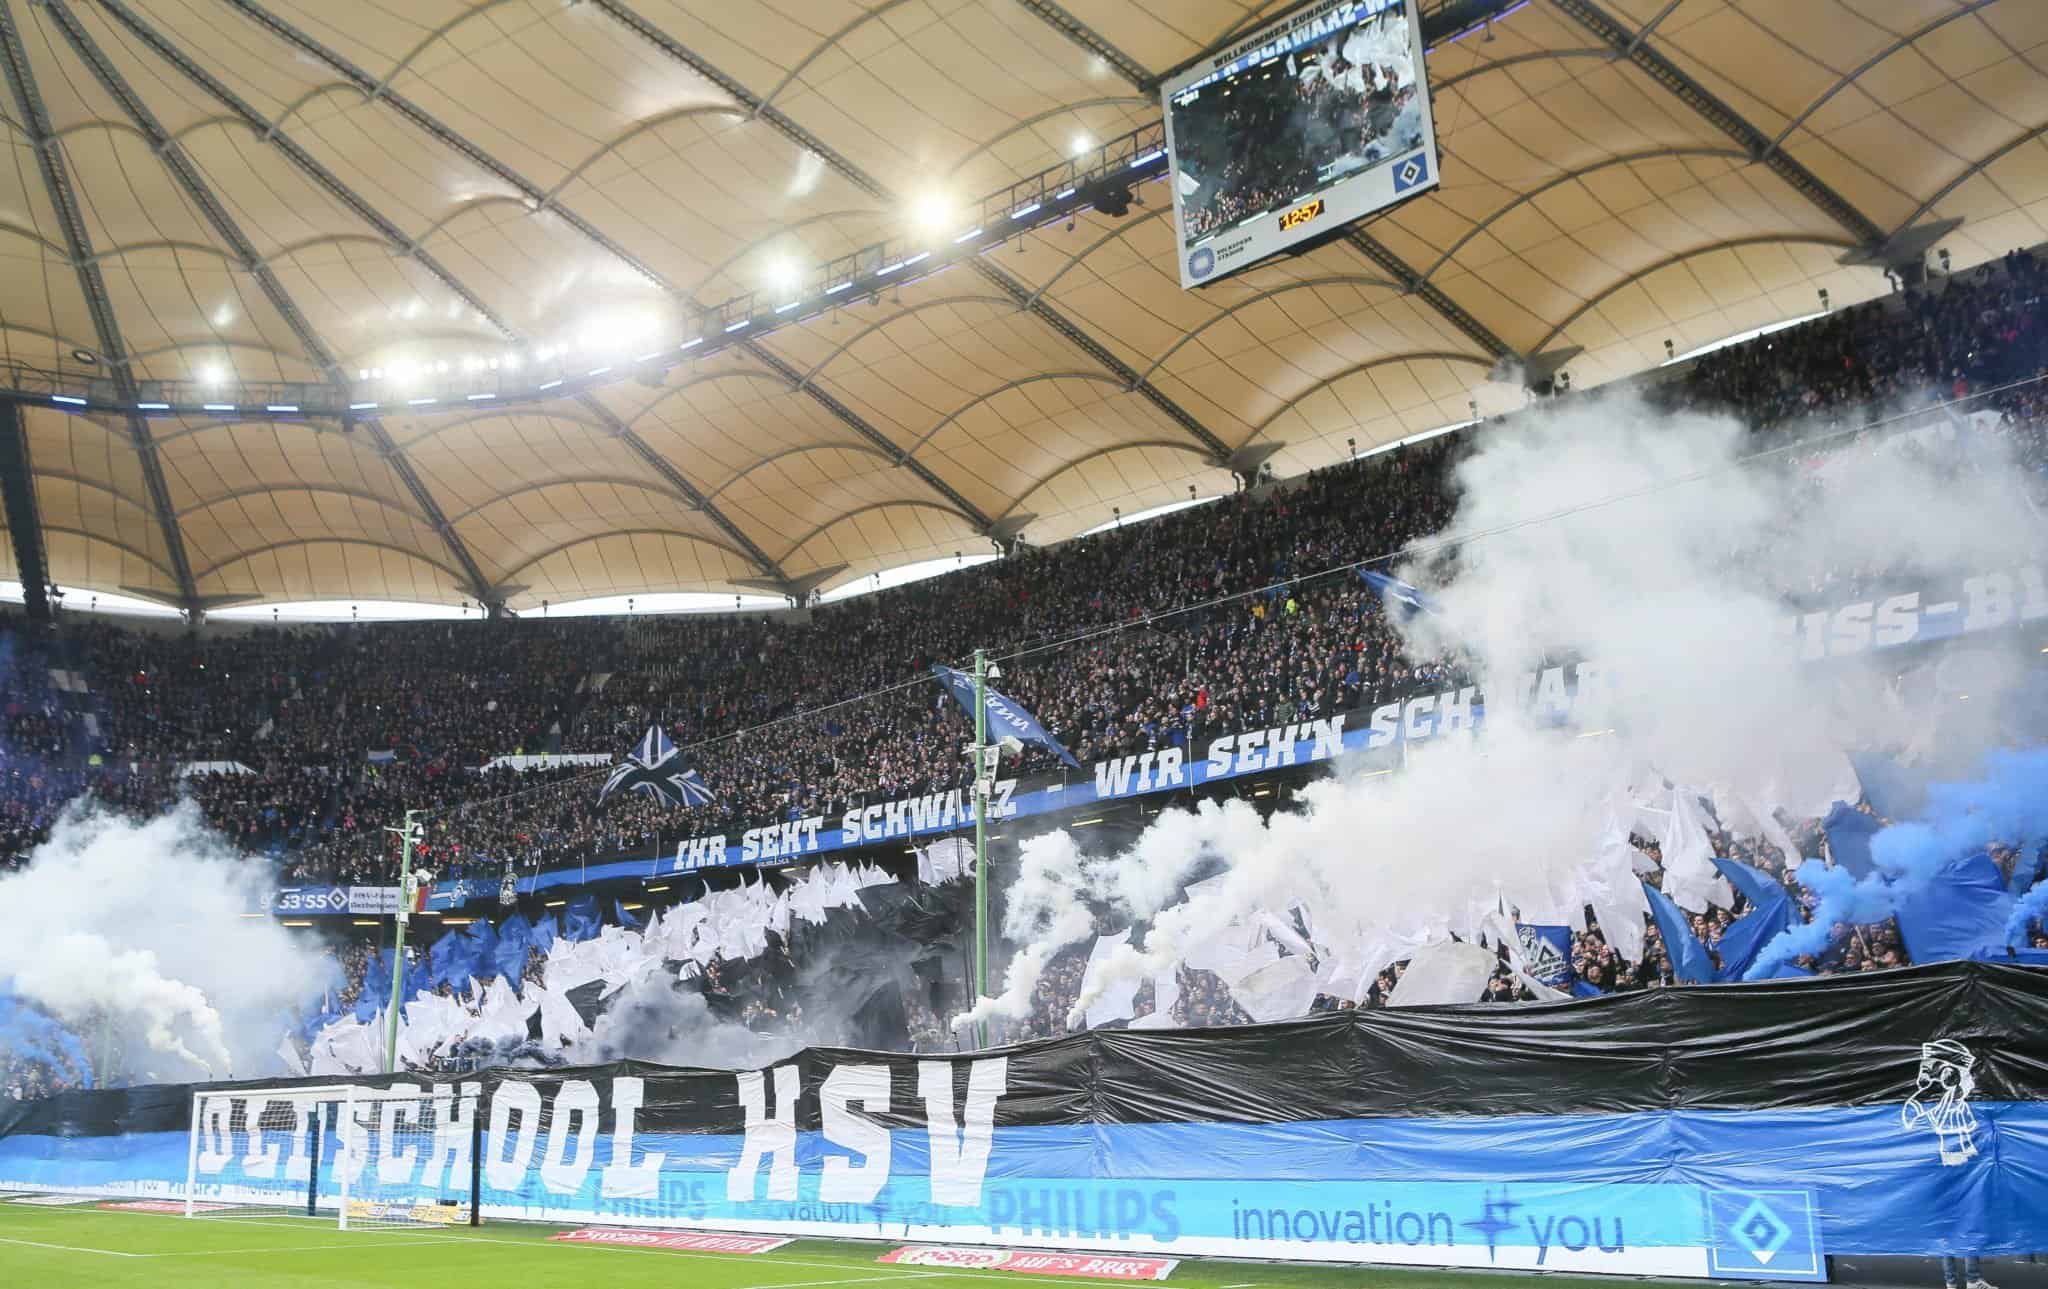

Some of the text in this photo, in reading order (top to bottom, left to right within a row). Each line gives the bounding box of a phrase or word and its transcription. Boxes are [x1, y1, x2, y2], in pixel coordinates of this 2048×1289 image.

[1282, 200, 1320, 231] 12:57
[673, 833, 727, 873] IHR
[741, 815, 825, 863] SEHT
[1094, 747, 1185, 798] WIR
[1206, 714, 1346, 778] SEH'N
[727, 1056, 1008, 1207] HSV
[989, 1187, 1181, 1243] PHILIPS
[1231, 1199, 1456, 1247] innovation
[1528, 1214, 1627, 1265] you
